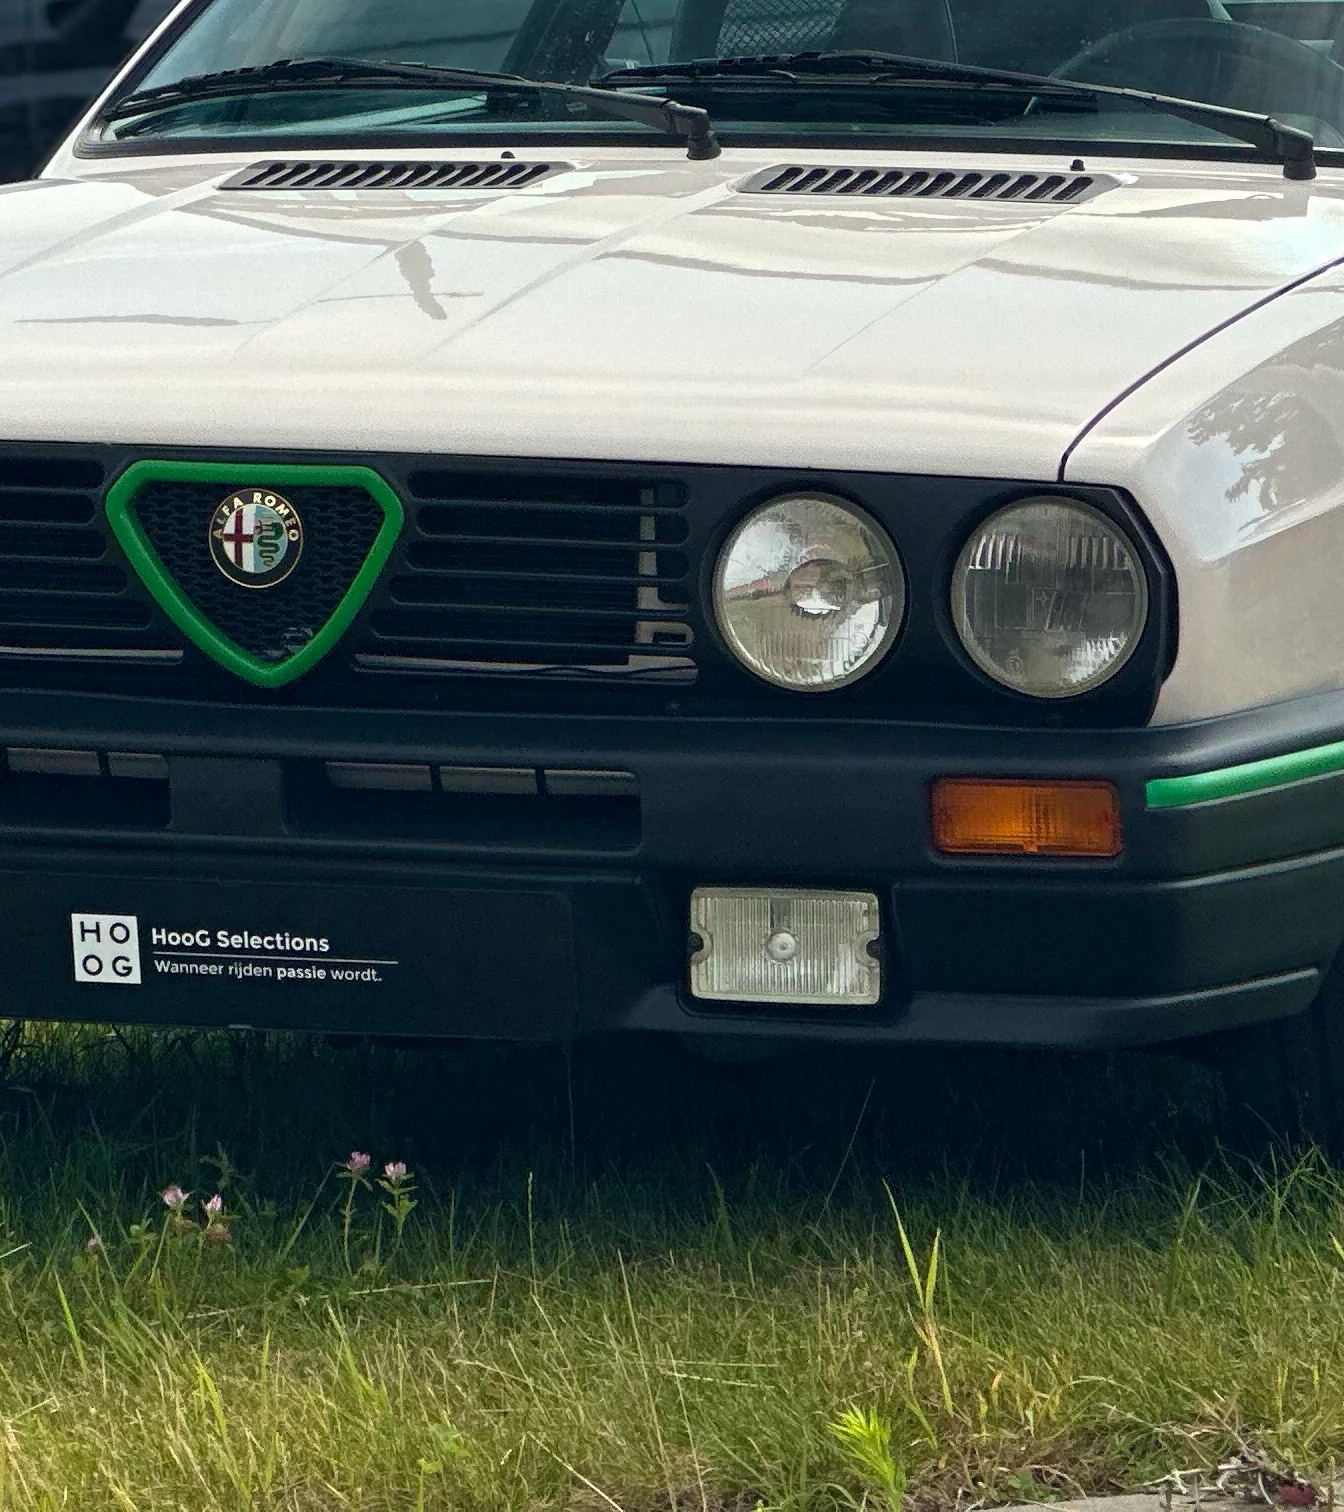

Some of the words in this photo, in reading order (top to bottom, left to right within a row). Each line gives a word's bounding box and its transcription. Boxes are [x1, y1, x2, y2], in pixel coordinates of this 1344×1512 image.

[212, 496, 244, 539] ALFA
[252, 492, 299, 541] ROMEO
[151, 927, 211, 947] HooG
[216, 930, 330, 952] Selections
[154, 959, 224, 976] Wanneer
[227, 961, 273, 980] rijden
[276, 966, 327, 981] passie
[330, 967, 383, 983] wordt.
